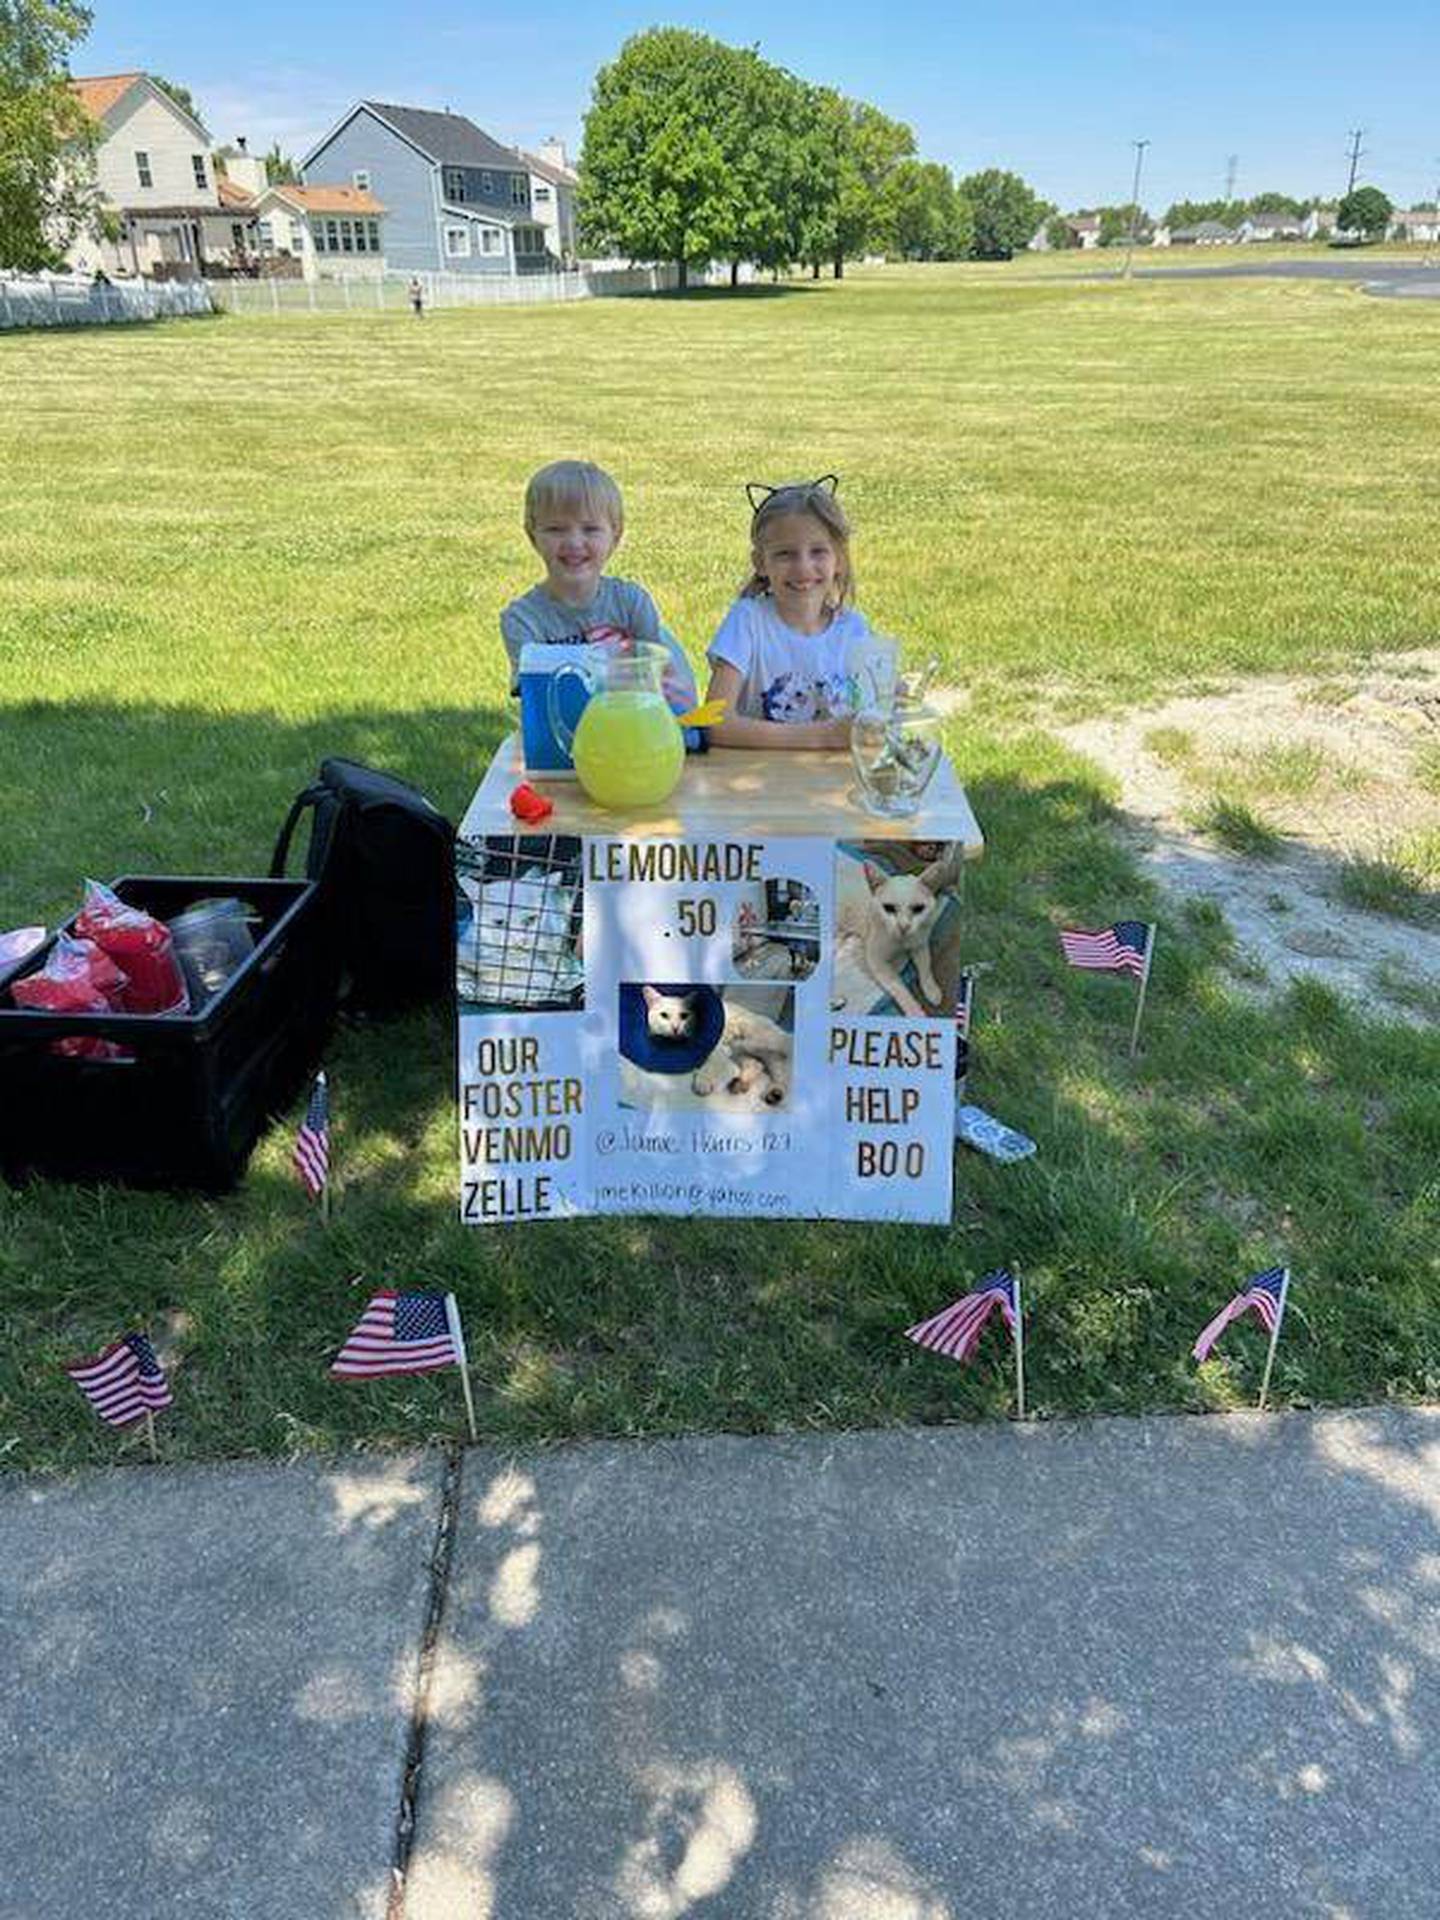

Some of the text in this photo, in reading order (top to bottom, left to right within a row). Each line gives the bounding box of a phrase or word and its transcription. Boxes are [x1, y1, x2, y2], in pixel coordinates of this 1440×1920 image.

[588, 842, 765, 884] LEMONADE
[663, 897, 718, 938] .50
[477, 1036, 540, 1077] OUR
[828, 1026, 943, 1070] PLEASE
[463, 1077, 583, 1121] FOSTER
[845, 1085, 920, 1125] HELP
[462, 1123, 572, 1166] VENMO
[857, 1140, 925, 1179] BOO
[462, 1175, 552, 1220] ZELLE
